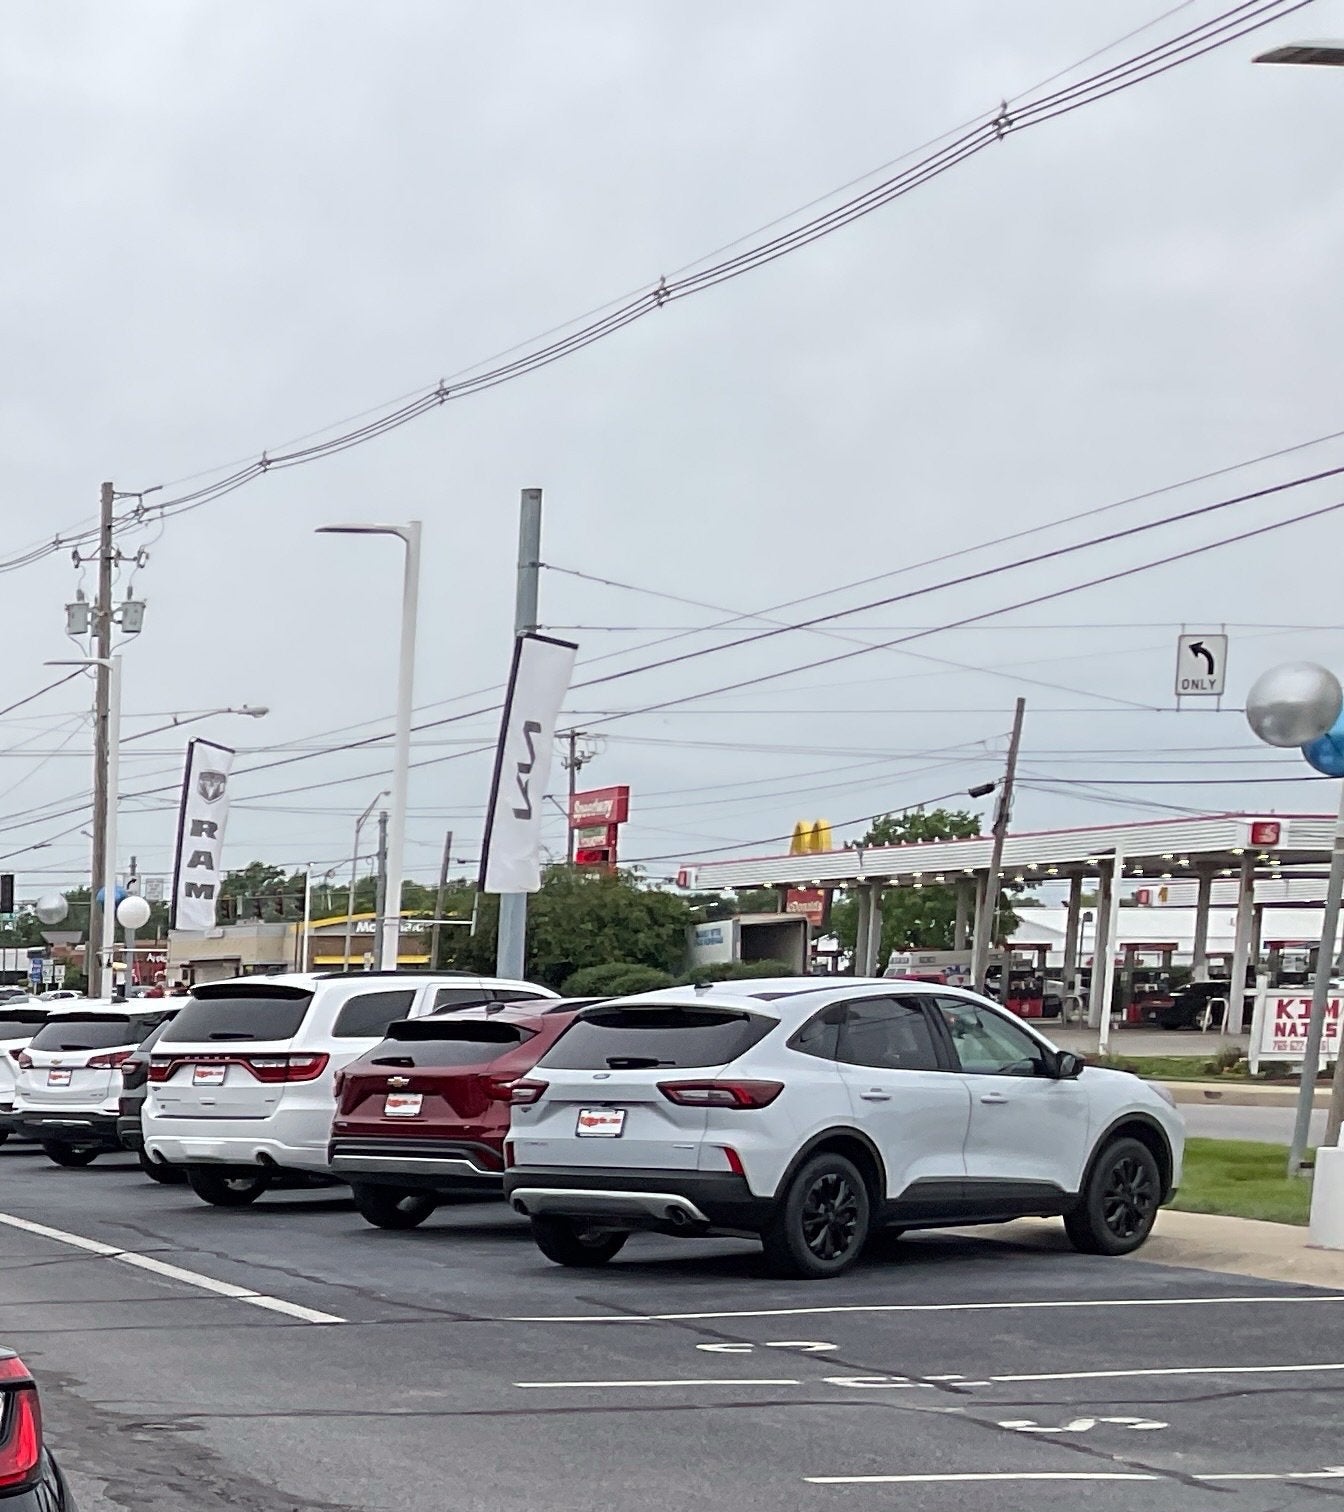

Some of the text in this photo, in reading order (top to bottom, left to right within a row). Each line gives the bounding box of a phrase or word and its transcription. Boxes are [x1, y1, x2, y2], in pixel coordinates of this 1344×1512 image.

[1181, 678, 1217, 691] ONLY
[183, 818, 218, 900] RAM
[1273, 1022, 1338, 1038] NAIS
